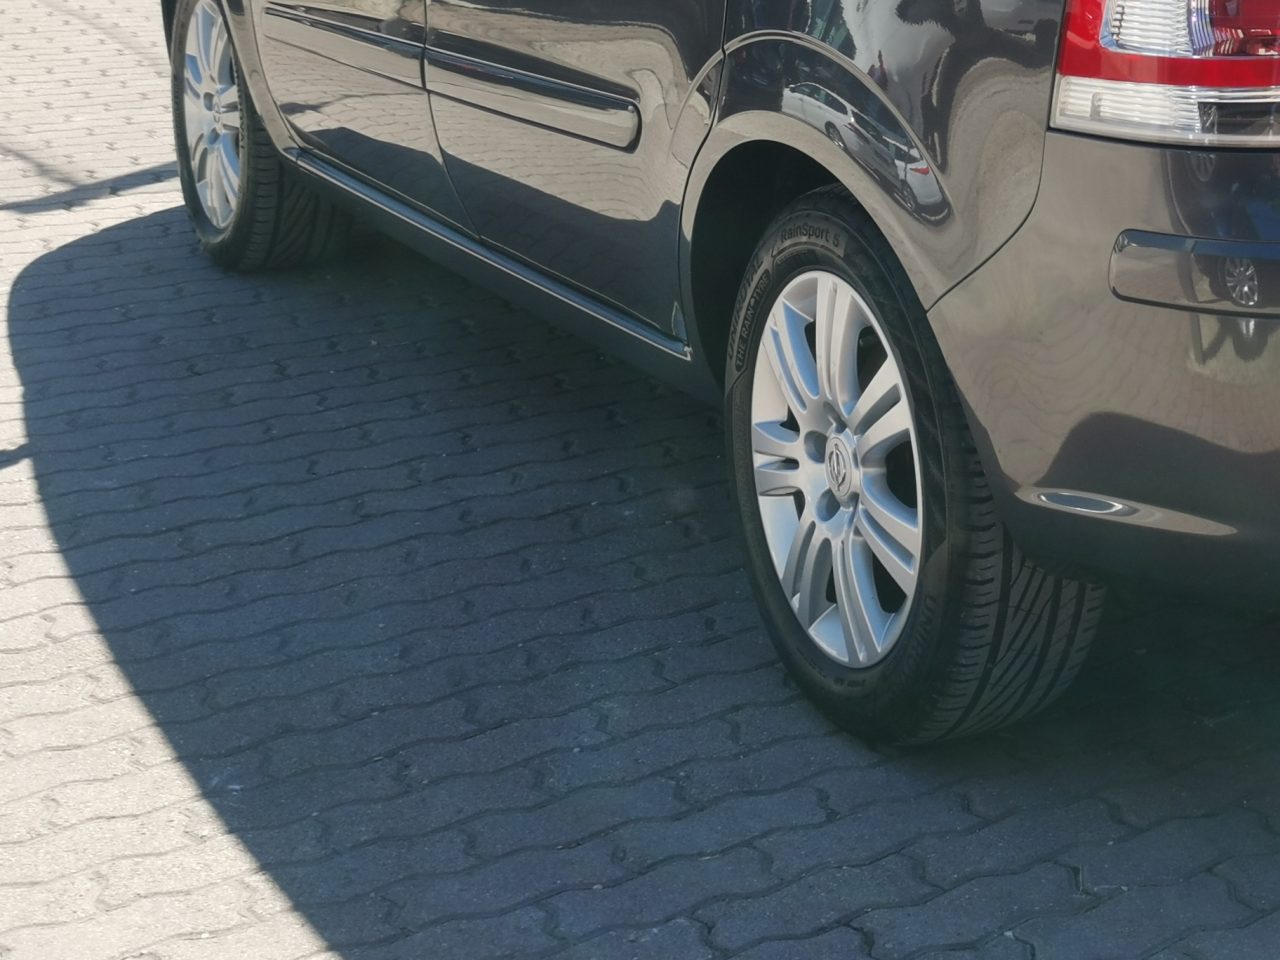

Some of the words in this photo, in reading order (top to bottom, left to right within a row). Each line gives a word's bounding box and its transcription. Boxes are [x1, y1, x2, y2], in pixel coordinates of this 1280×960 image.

[780, 222, 830, 244] RainSport
[740, 307, 755, 339] RAIN
[753, 273, 769, 304] TYRE
